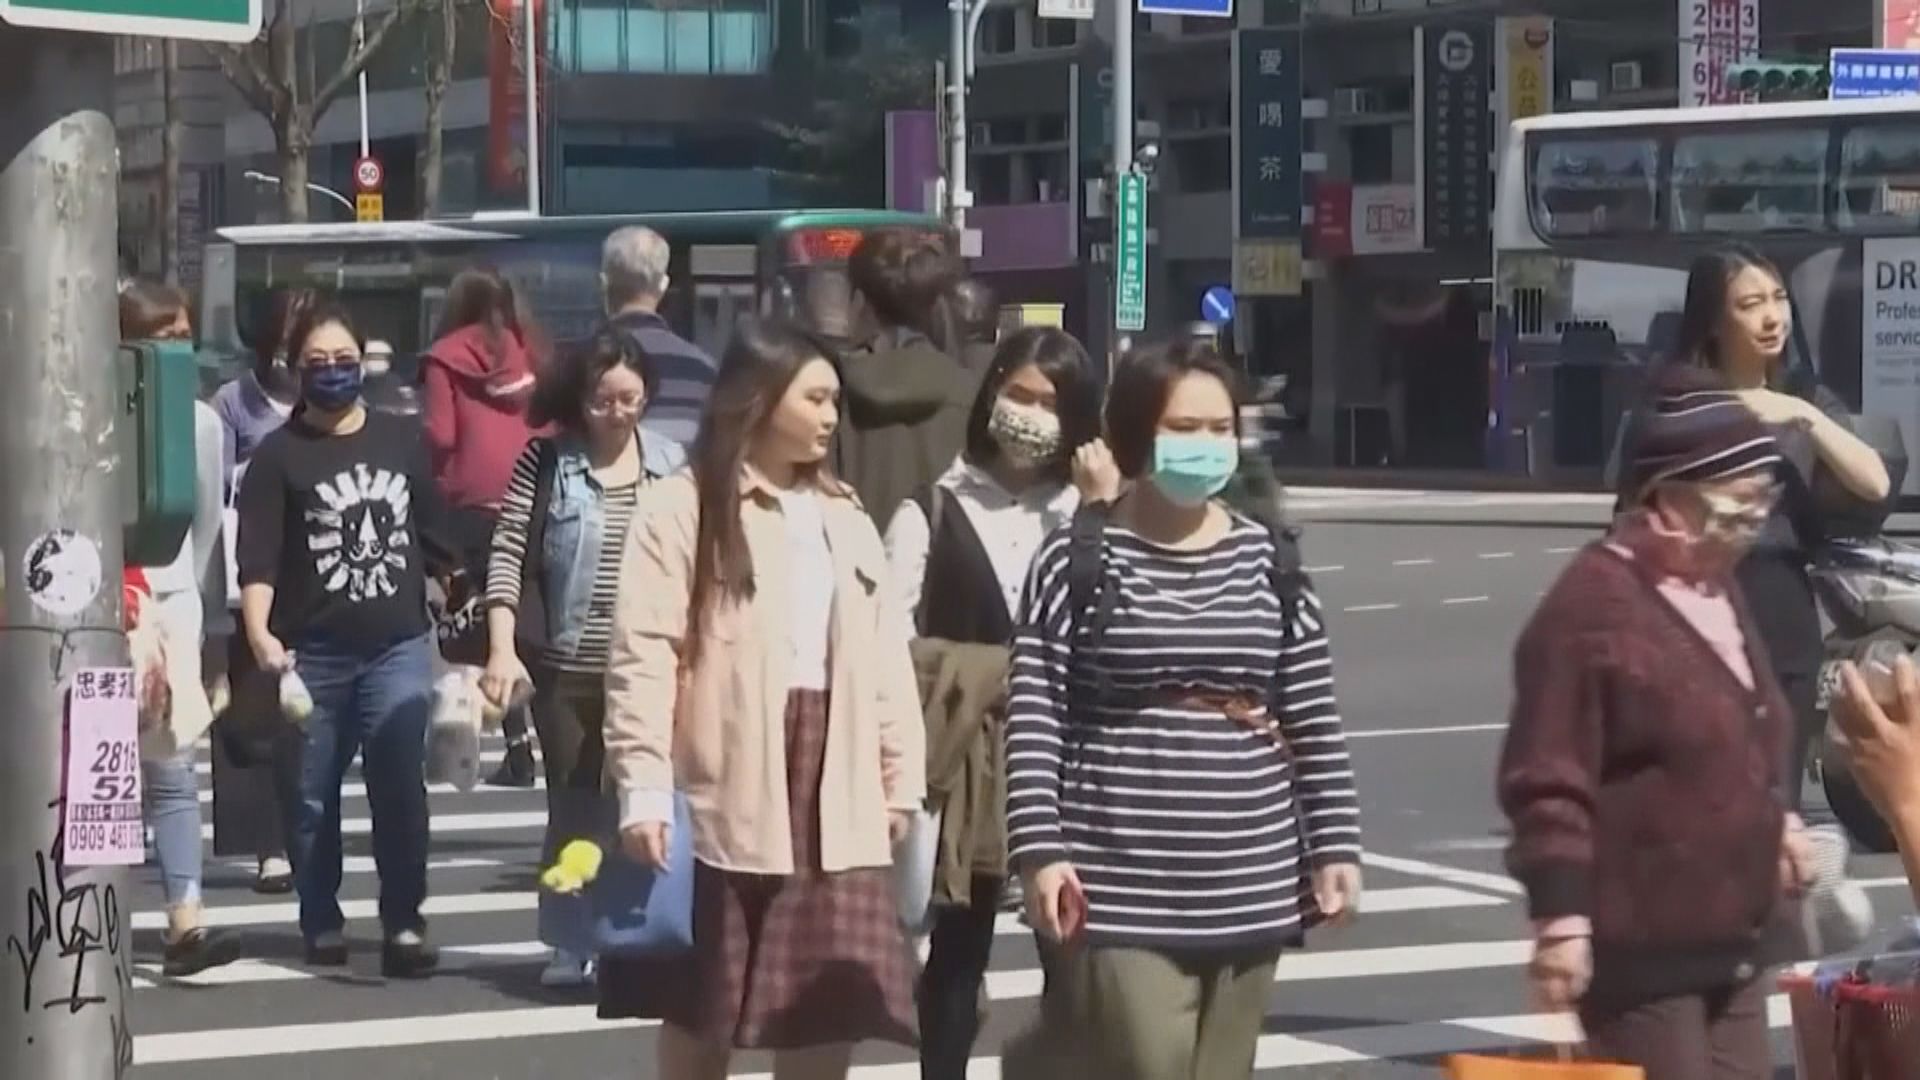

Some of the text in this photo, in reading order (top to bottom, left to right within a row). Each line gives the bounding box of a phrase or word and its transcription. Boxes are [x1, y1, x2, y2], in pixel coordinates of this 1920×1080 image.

[361, 167, 377, 180] 50
[92, 776, 136, 801] 52
[69, 824, 105, 850] 0909
